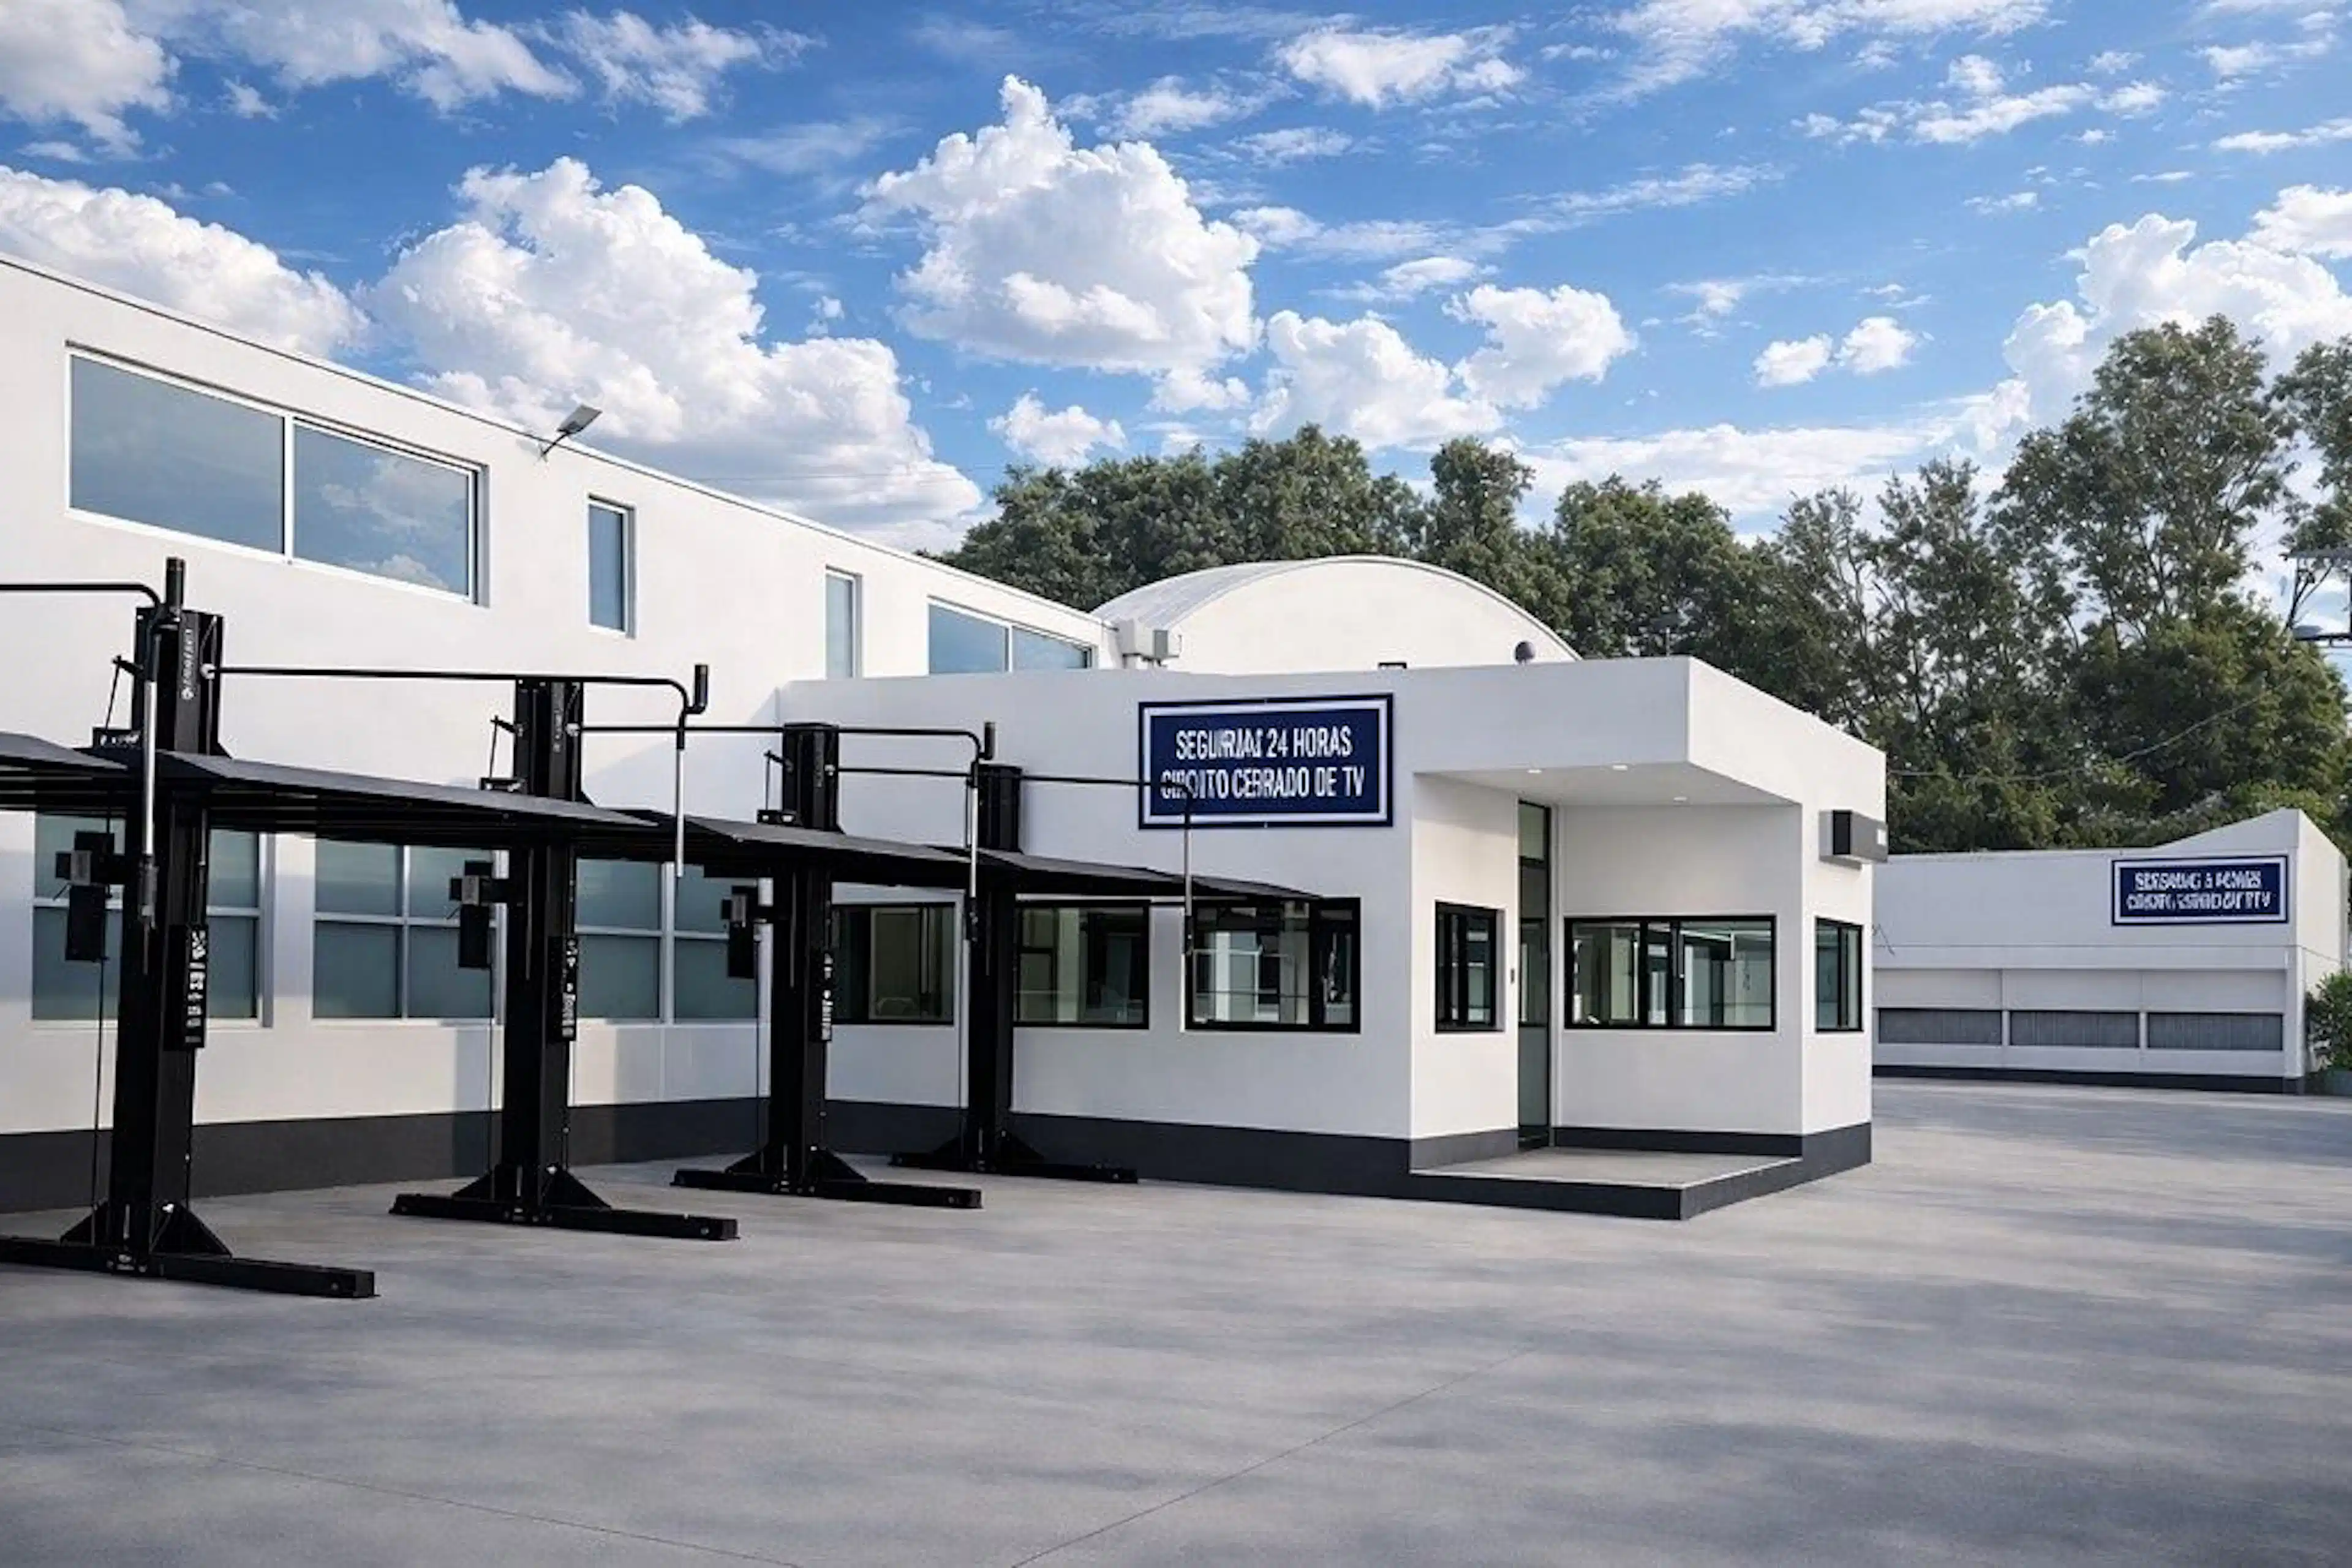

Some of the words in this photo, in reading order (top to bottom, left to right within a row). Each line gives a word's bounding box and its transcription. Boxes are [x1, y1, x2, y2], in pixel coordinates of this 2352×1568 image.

[1265, 727, 1289, 758] 24
[1293, 725, 1353, 758] HORAS
[1231, 766, 1310, 799] CERRADO
[1314, 766, 1338, 797] DE
[1341, 765, 1365, 797] TV
